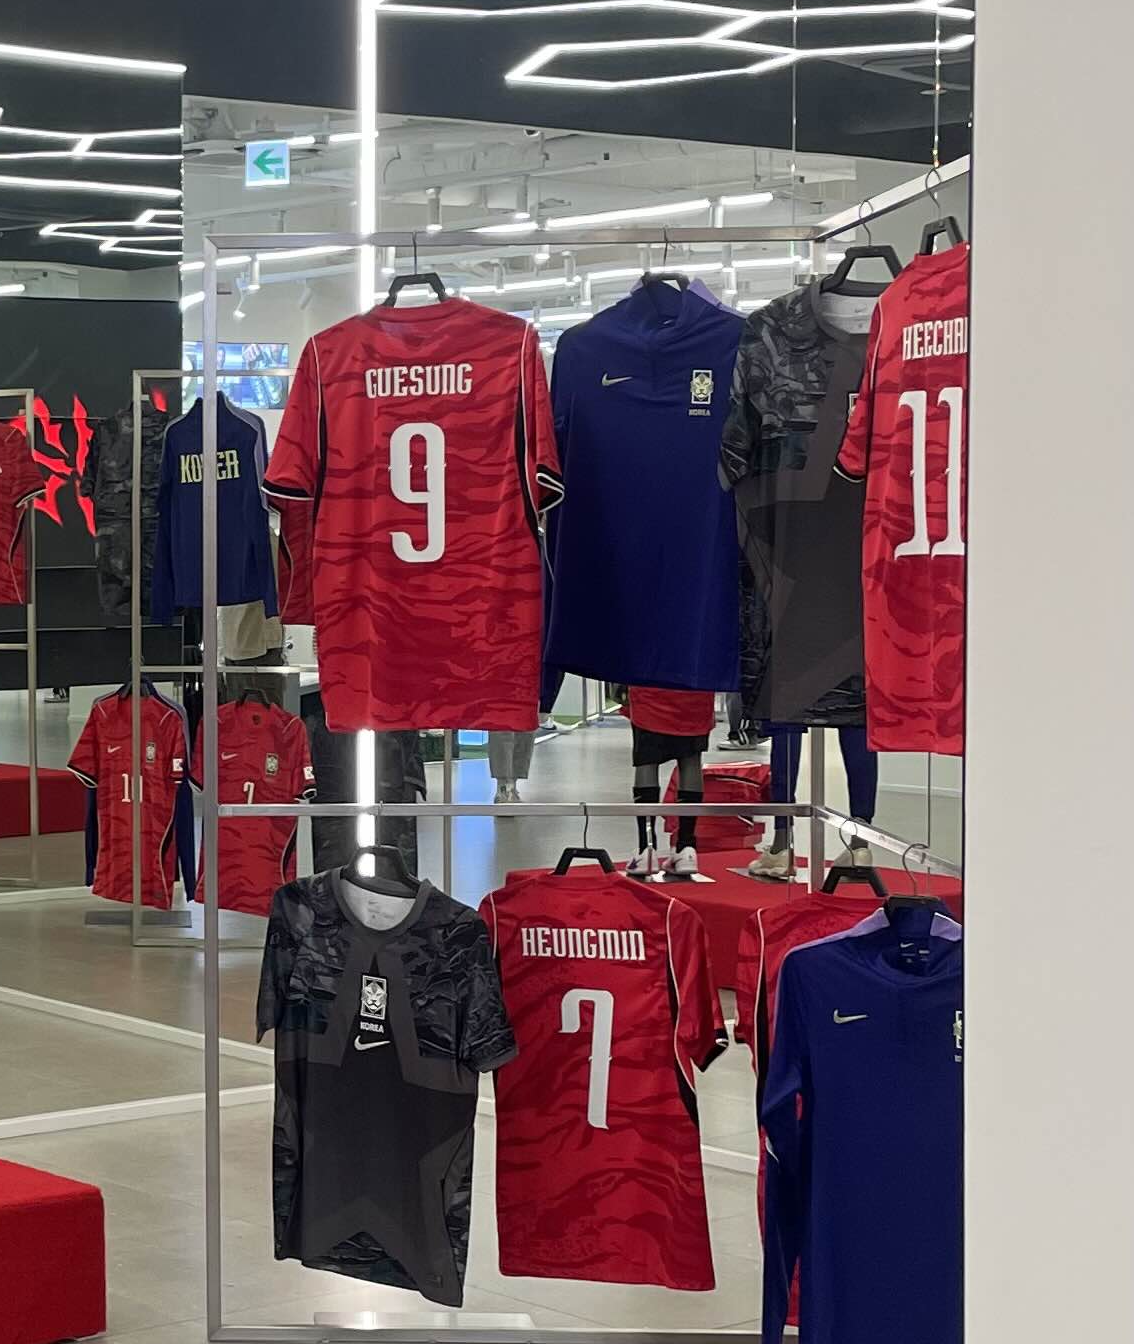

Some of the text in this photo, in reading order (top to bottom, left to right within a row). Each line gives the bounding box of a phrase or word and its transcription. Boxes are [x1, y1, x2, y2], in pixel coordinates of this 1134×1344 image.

[365, 363, 473, 399] GUESUNG
[388, 422, 447, 563] 9
[894, 386, 965, 560] 11
[521, 927, 646, 961] HEUNGMIN
[558, 988, 614, 1130] 7
